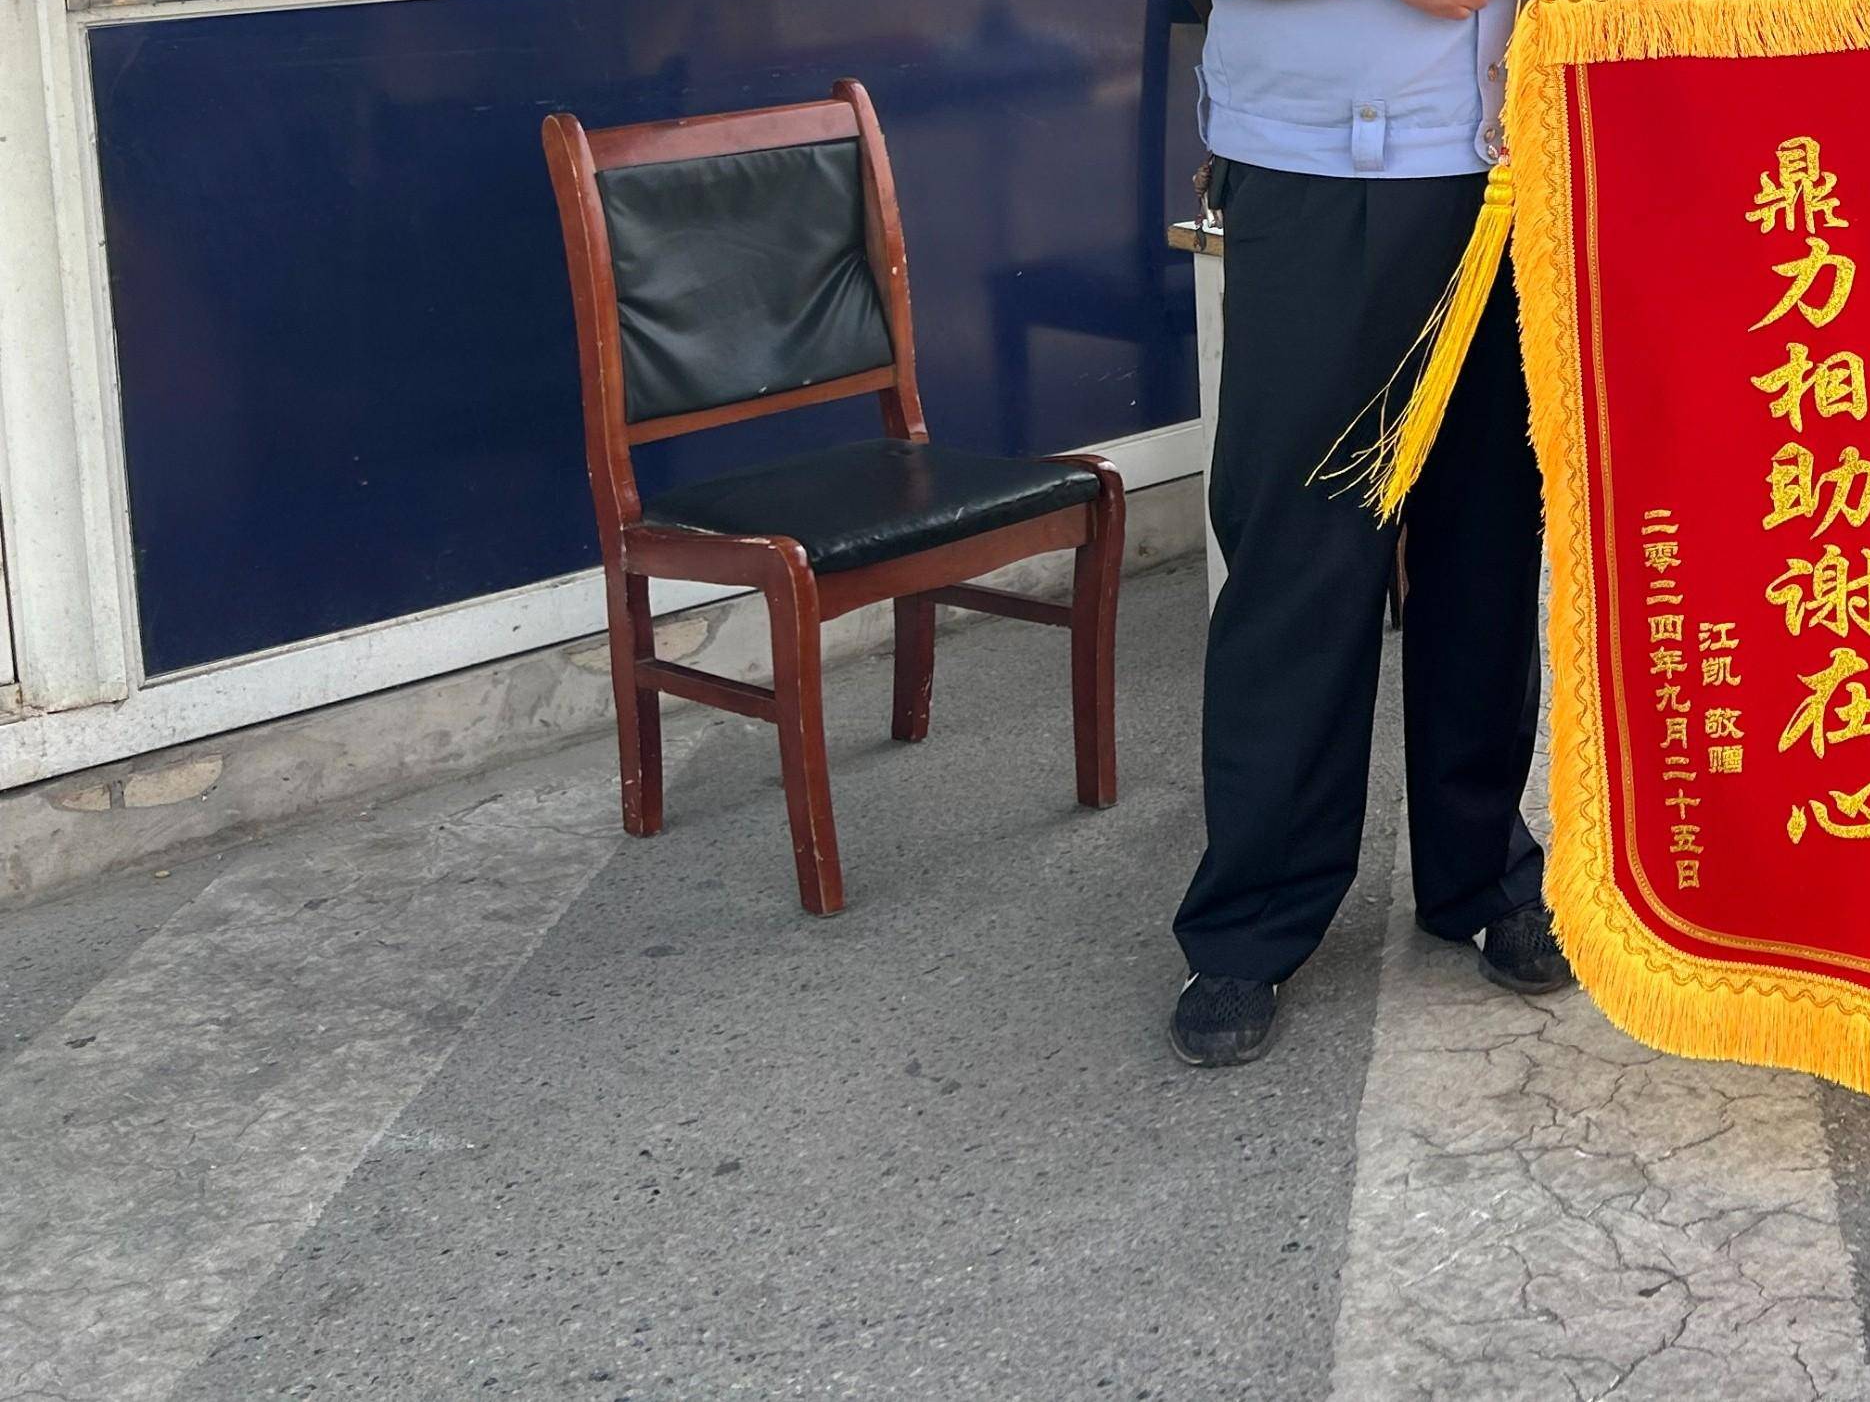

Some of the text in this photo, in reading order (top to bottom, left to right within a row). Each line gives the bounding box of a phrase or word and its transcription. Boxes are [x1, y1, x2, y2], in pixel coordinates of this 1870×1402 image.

[1640, 509, 1705, 890] 二零二四年九月二十五日
[1698, 622, 1745, 775] 江凯 敬赠
